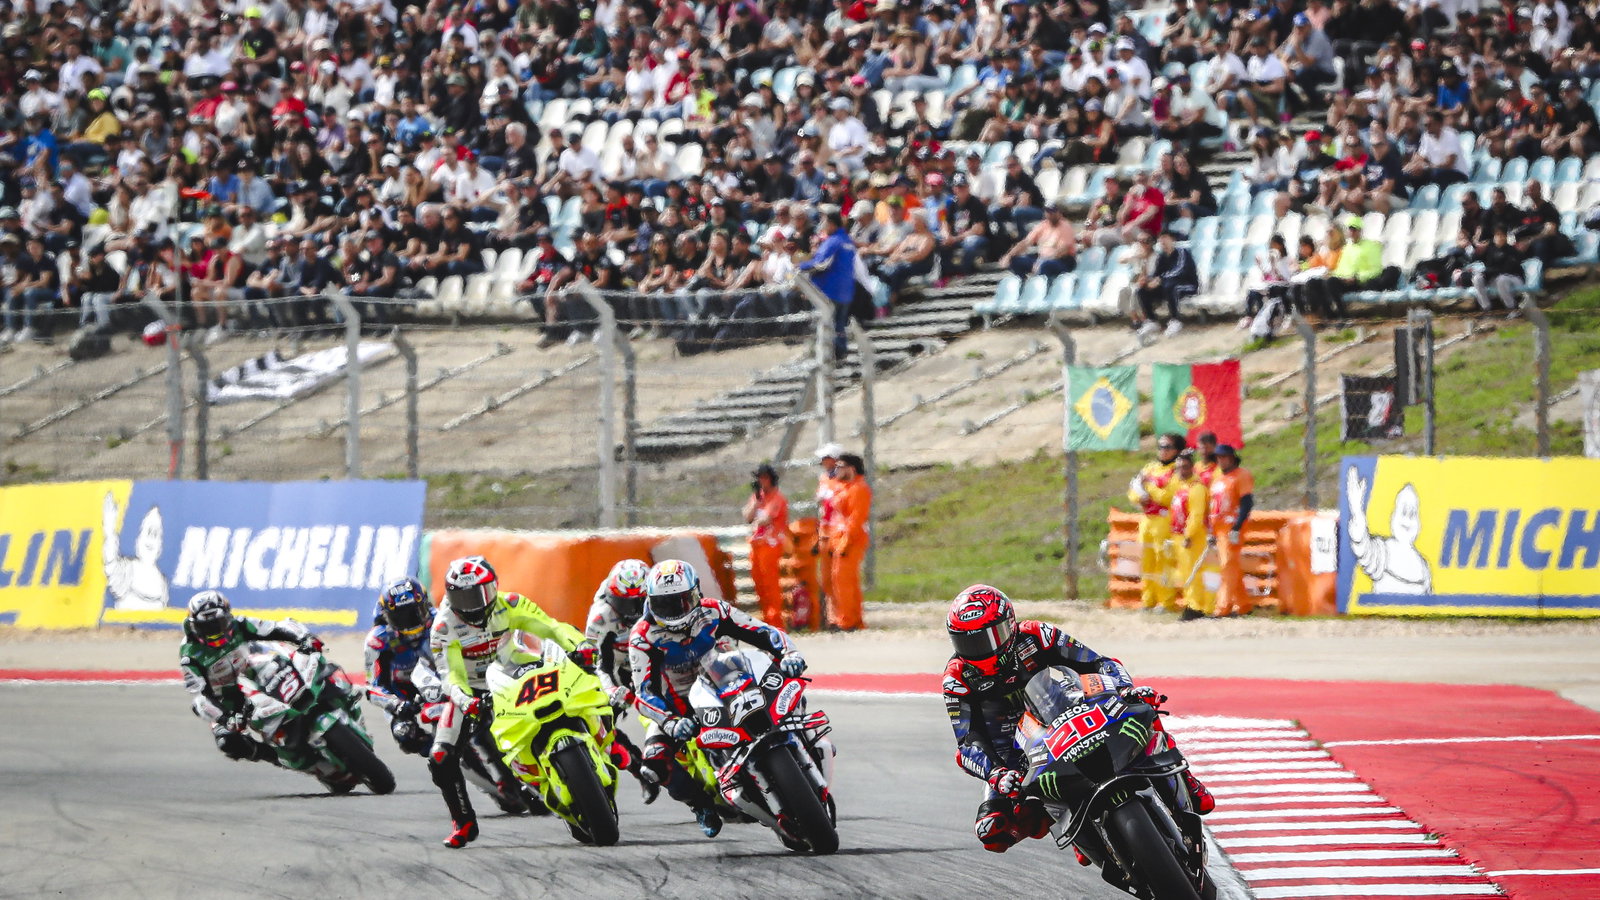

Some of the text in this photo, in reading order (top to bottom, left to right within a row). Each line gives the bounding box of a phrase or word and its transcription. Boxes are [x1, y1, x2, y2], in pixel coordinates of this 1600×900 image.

[1438, 507, 1600, 570] MICH
[172, 524, 418, 590] MICHELIN
[515, 670, 559, 709] 49
[730, 687, 766, 728] 25
[778, 681, 799, 713] sterilgarda
[1043, 703, 1109, 761] 20
[1051, 703, 1090, 729] ENEOS
[702, 730, 739, 743] sterilgarda
[1062, 730, 1111, 763] MONSTER
[960, 753, 986, 780] YAMAHA
